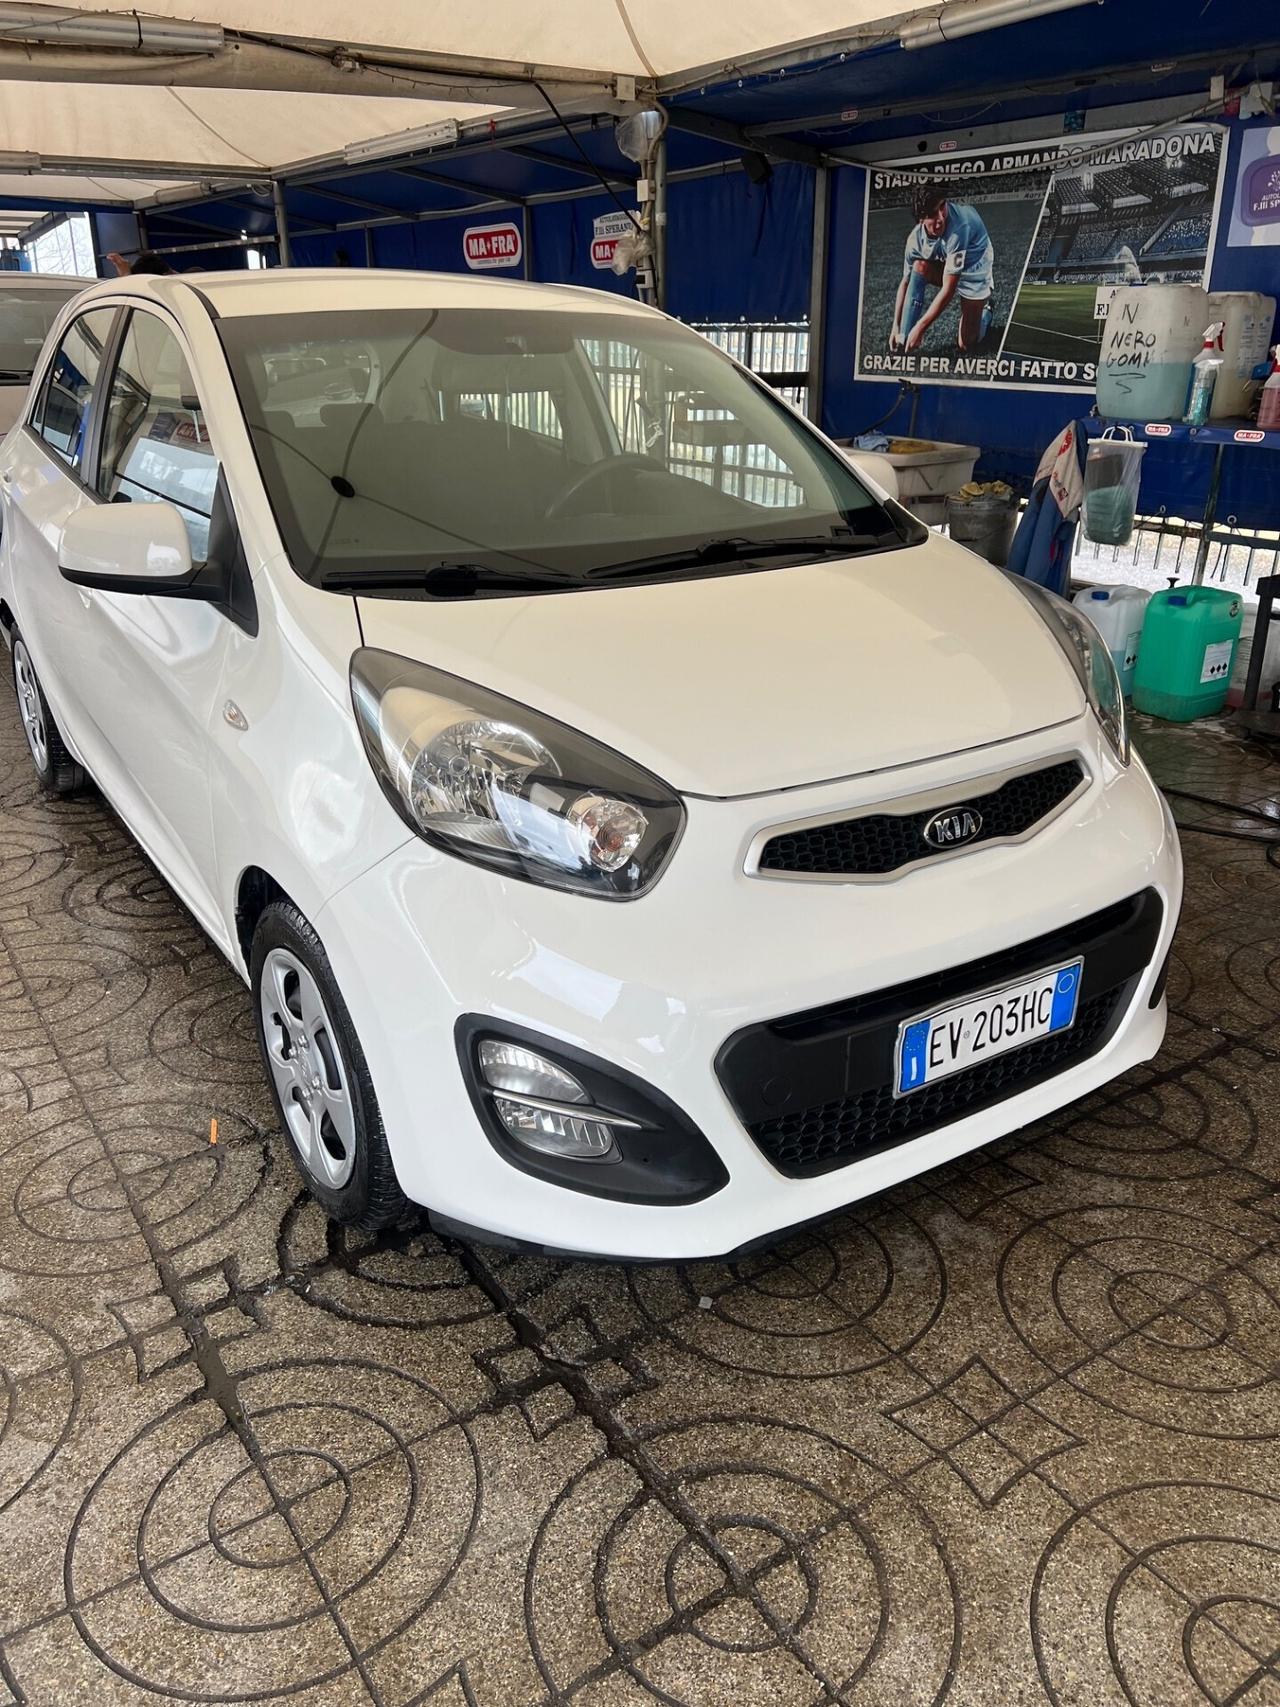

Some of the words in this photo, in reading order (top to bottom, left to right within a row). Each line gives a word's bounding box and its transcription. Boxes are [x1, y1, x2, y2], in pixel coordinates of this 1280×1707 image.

[874, 167, 929, 190] STADIO
[934, 160, 986, 183] DIEGO
[990, 146, 1084, 172] ARMANDO
[1088, 132, 1216, 167] MARADONA
[1110, 330, 1157, 349] NERO
[862, 354, 916, 373] GRAZIE
[920, 356, 950, 374] PER
[953, 358, 1015, 377] AVERCI
[1020, 360, 1078, 381] FATTO
[1082, 362, 1099, 381] S
[933, 812, 977, 843] KIA
[929, 1017, 964, 1068] EV
[972, 987, 1054, 1052] 203HC
